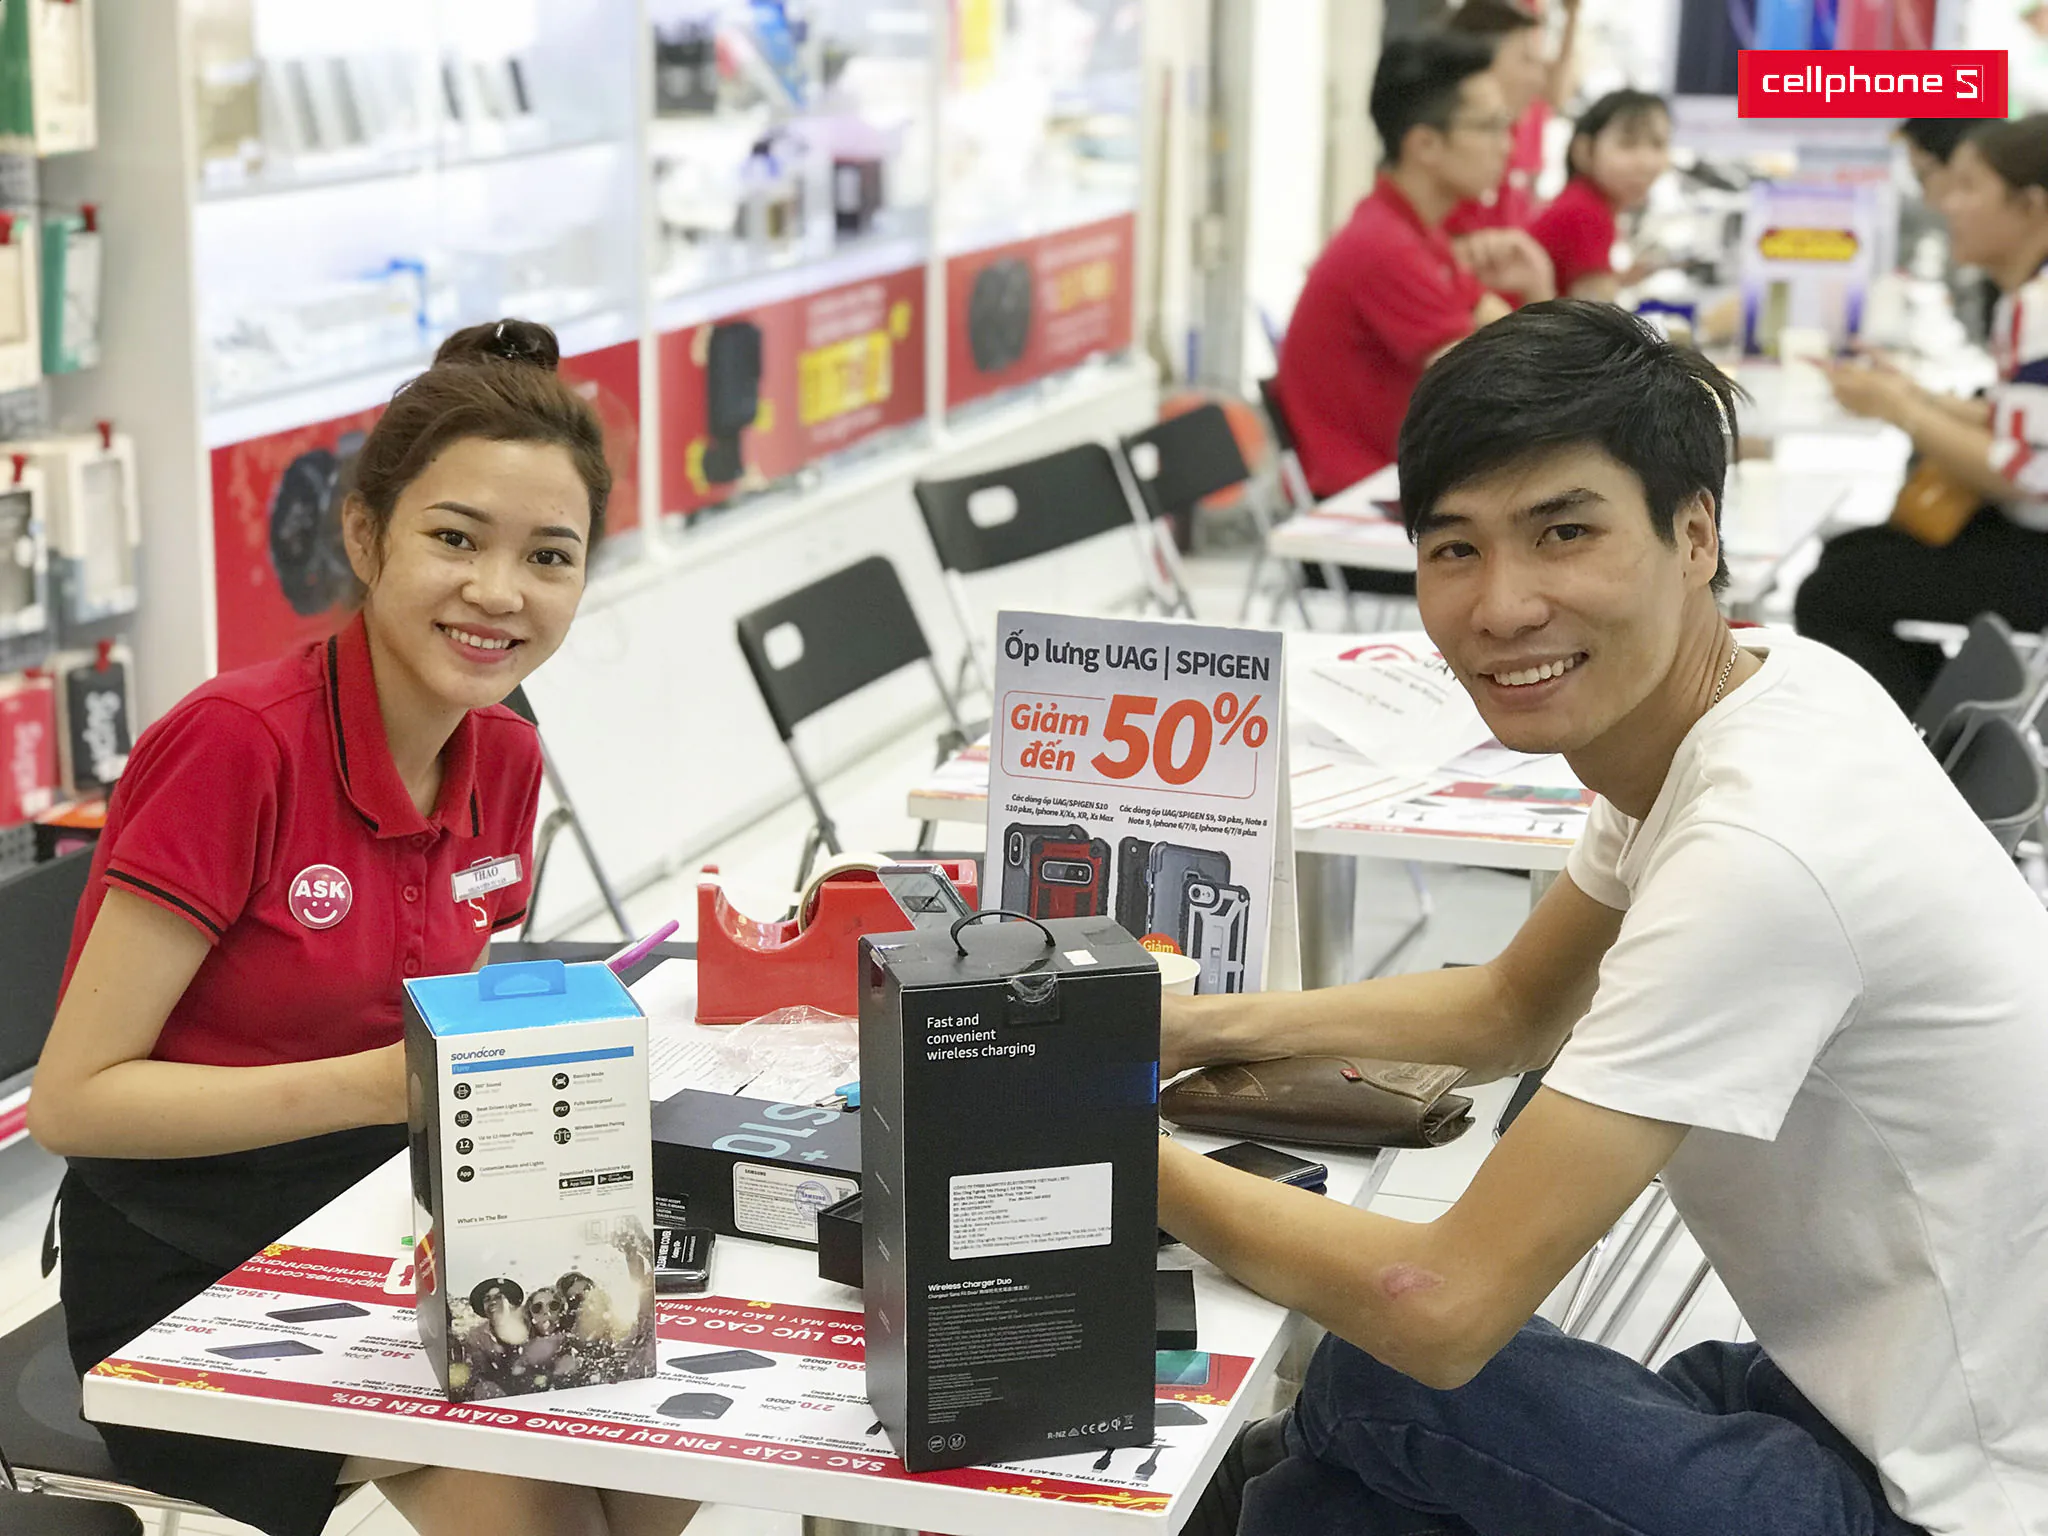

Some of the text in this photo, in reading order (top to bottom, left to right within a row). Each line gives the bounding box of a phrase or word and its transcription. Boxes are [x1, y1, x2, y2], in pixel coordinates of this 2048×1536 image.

[1004, 629, 1270, 681] Ốp lưng UAG SPIGEN
[1010, 701, 1090, 737] Giảm
[1090, 691, 1268, 785] 50%
[1020, 739, 1076, 772] đến
[1005, 804, 1018, 812] S10
[1052, 798, 1094, 810] UAG/SPIGEN
[1095, 802, 1108, 810] S10
[1128, 816, 1145, 825] Note
[1162, 808, 1205, 820] UAG/SPIGEN
[294, 880, 346, 899] ASK
[927, 1013, 979, 1028] Fast and
[926, 1028, 996, 1045] convenient
[450, 1046, 506, 1060] soundcore
[926, 1042, 1036, 1060] wireless charging
[661, 1230, 672, 1244] COVER
[248, 1256, 390, 1279] ntamkhachhang
[242, 1265, 386, 1288] ellphones.com.vn
[928, 1282, 961, 1292] Wireless
[962, 1279, 996, 1289] Charger
[656, 1312, 698, 1327] CẤ
[704, 1319, 765, 1334] CAO
[331, 1392, 886, 1472] SẠC CÁP PIN DỰ PHÒNG GIẢM ĐẾN 50%
